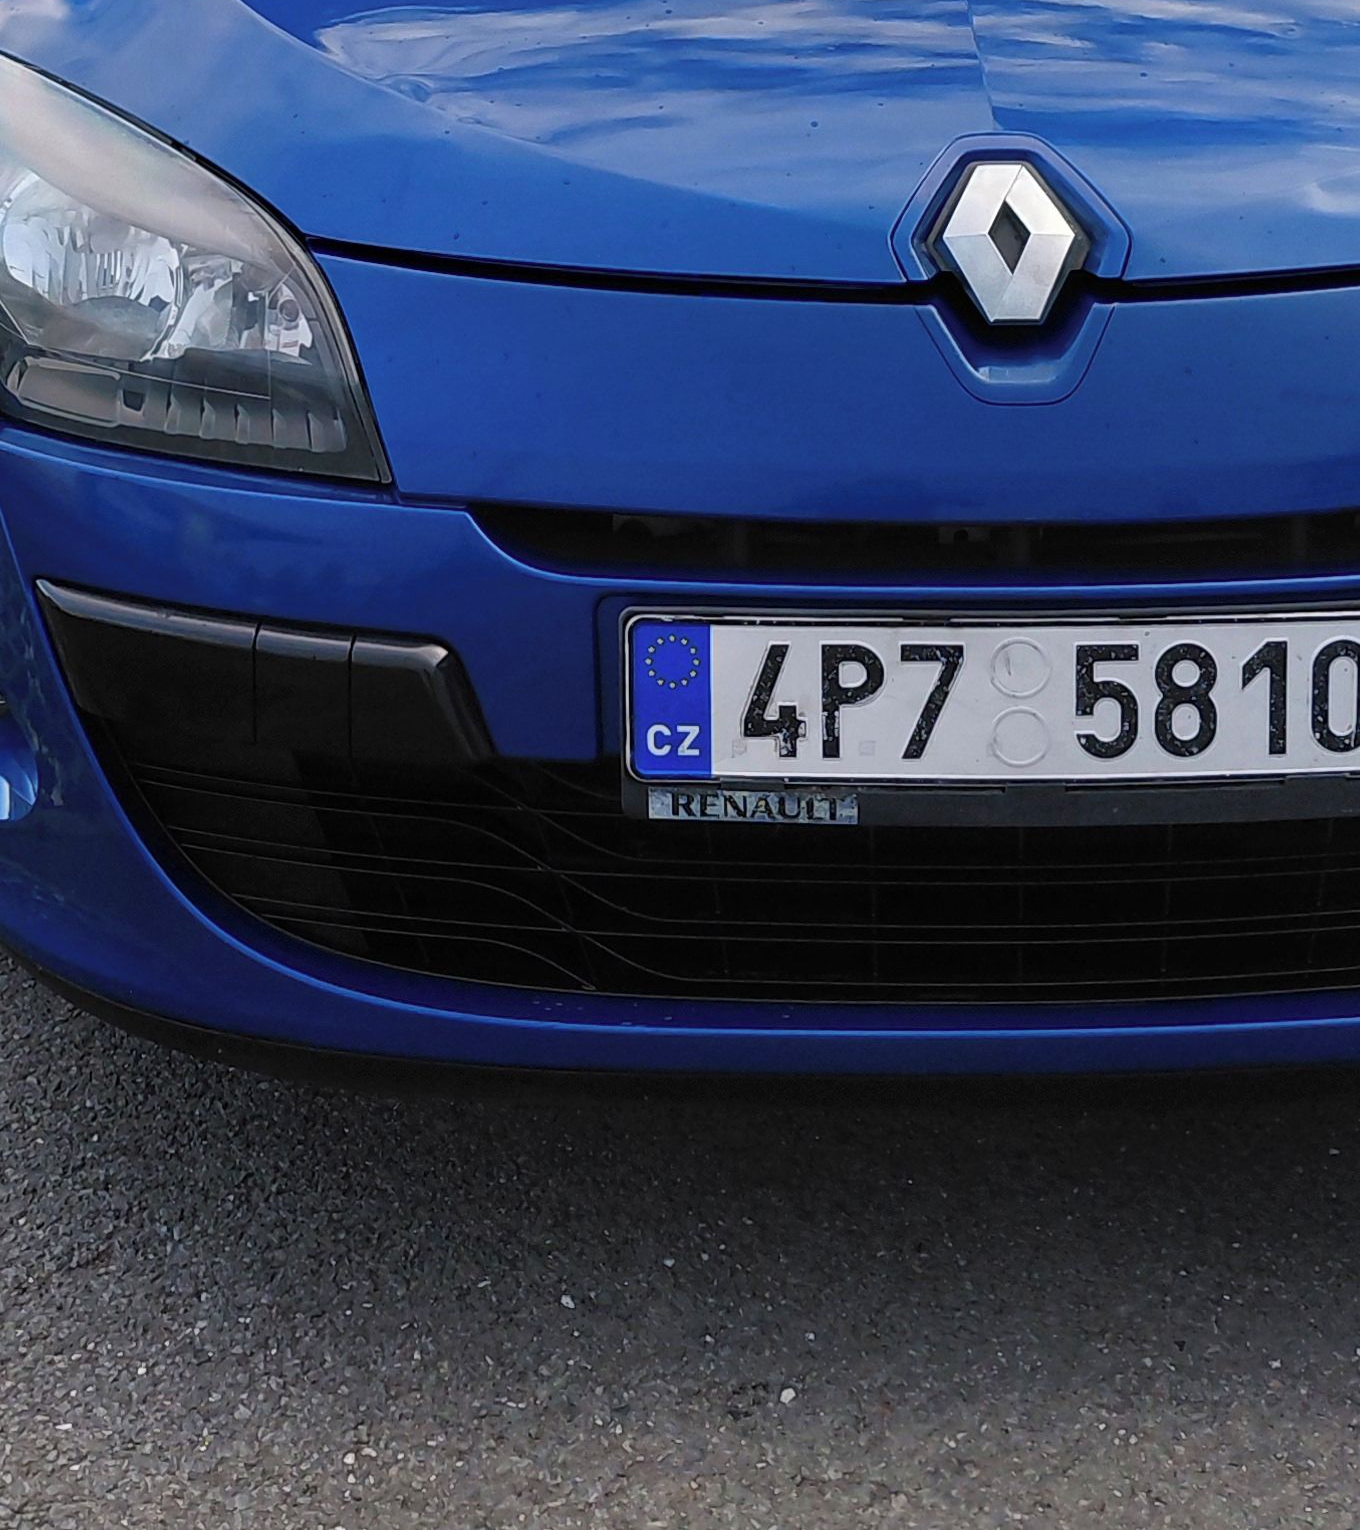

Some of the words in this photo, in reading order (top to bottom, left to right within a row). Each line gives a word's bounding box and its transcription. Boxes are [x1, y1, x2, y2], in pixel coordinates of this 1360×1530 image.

[743, 643, 966, 760] 4P7
[646, 724, 700, 756] CZ
[671, 792, 843, 821] RENAULT
